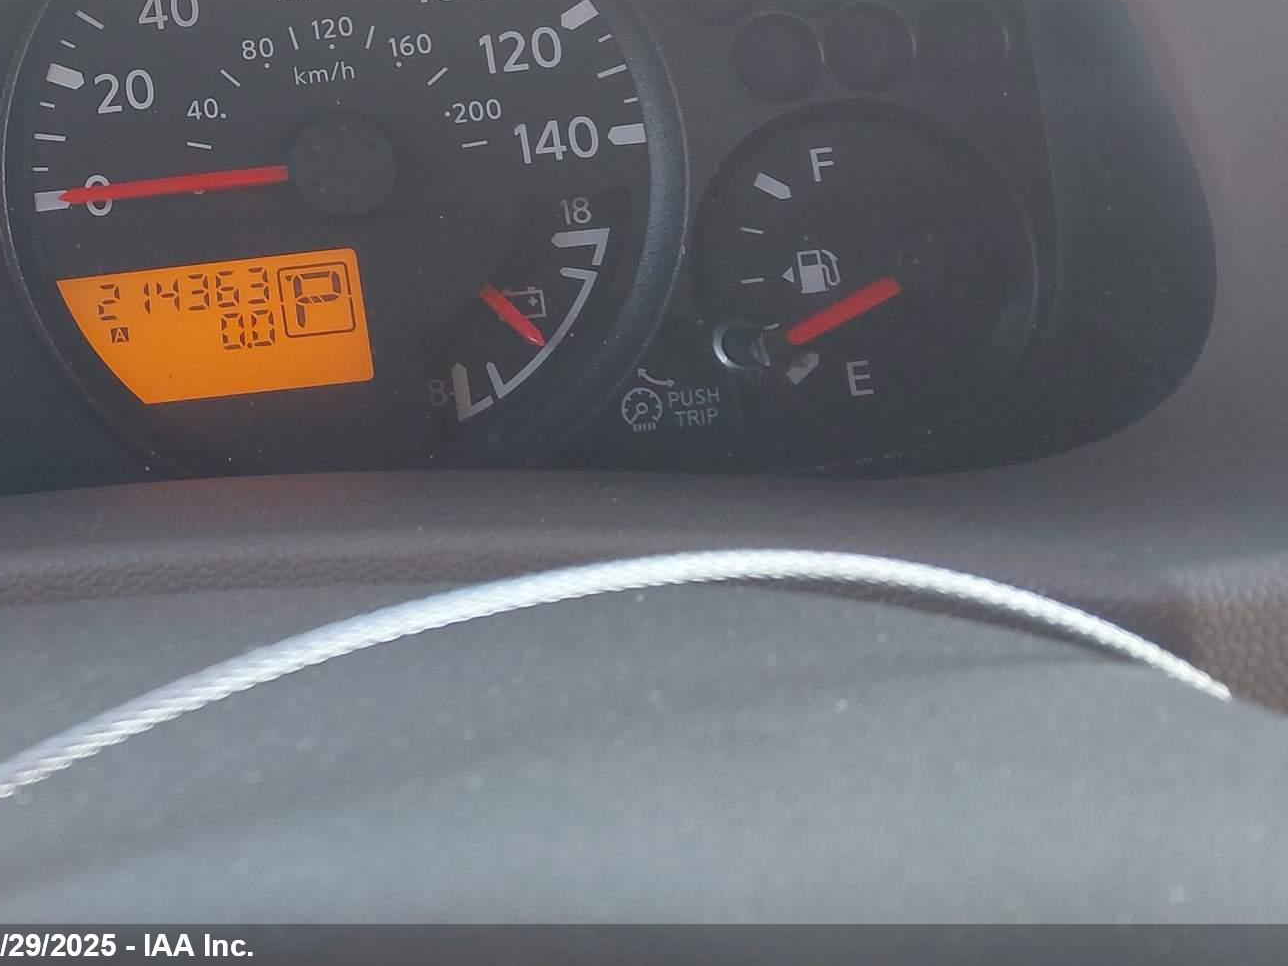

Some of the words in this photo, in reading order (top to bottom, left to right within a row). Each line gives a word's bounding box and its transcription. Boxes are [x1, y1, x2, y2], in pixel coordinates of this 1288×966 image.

[310, 15, 354, 40] 120
[241, 36, 275, 60] 80
[387, 33, 432, 59] 160
[478, 26, 562, 74] 120
[293, 62, 356, 87] km/h
[94, 69, 155, 114] 20
[187, 97, 220, 120] 40
[513, 116, 599, 164] 140
[810, 147, 834, 182] F
[84, 174, 113, 216] 0
[560, 198, 594, 224] 18
[221, 309, 275, 350] 0.0
[846, 360, 875, 397] E
[667, 387, 721, 406] PUSH
[674, 407, 720, 427] TRIP
